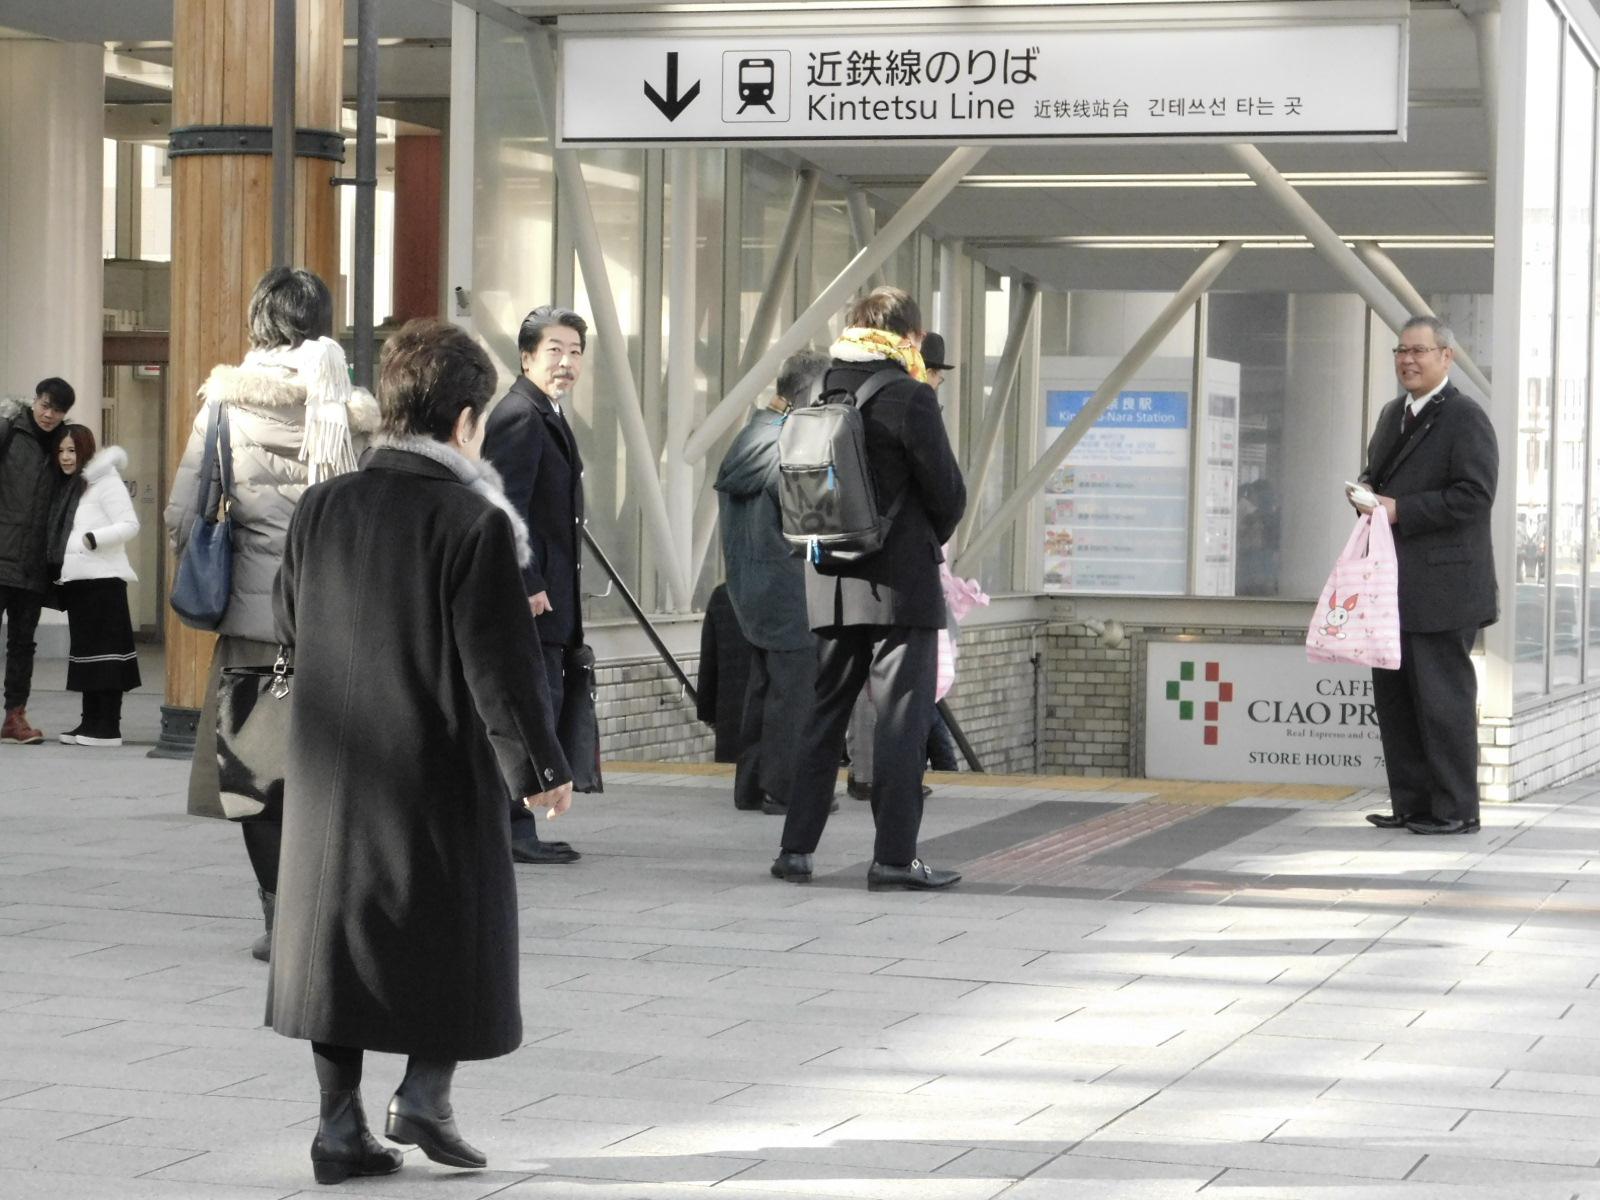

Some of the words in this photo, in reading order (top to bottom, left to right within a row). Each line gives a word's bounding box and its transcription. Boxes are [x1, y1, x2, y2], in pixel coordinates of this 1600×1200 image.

[807, 46, 1041, 87] 近鉄線のりば
[808, 93, 937, 121] Kintetsu
[951, 91, 1015, 120] Line
[1034, 99, 1130, 118] 近铁线站台
[1148, 97, 1227, 117] 긴테쓰선
[1236, 96, 1275, 117] 타는
[1283, 96, 1304, 116] 곳
[1136, 413, 1176, 424] Station
[1247, 699, 1331, 725] CIAO
[1286, 728, 1306, 738] Real
[1309, 729, 1346, 741] Espresso
[1347, 730, 1364, 740] and
[1367, 731, 1382, 741] Ca
[1248, 751, 1302, 765] STORE
[1305, 753, 1362, 768] HOURS
